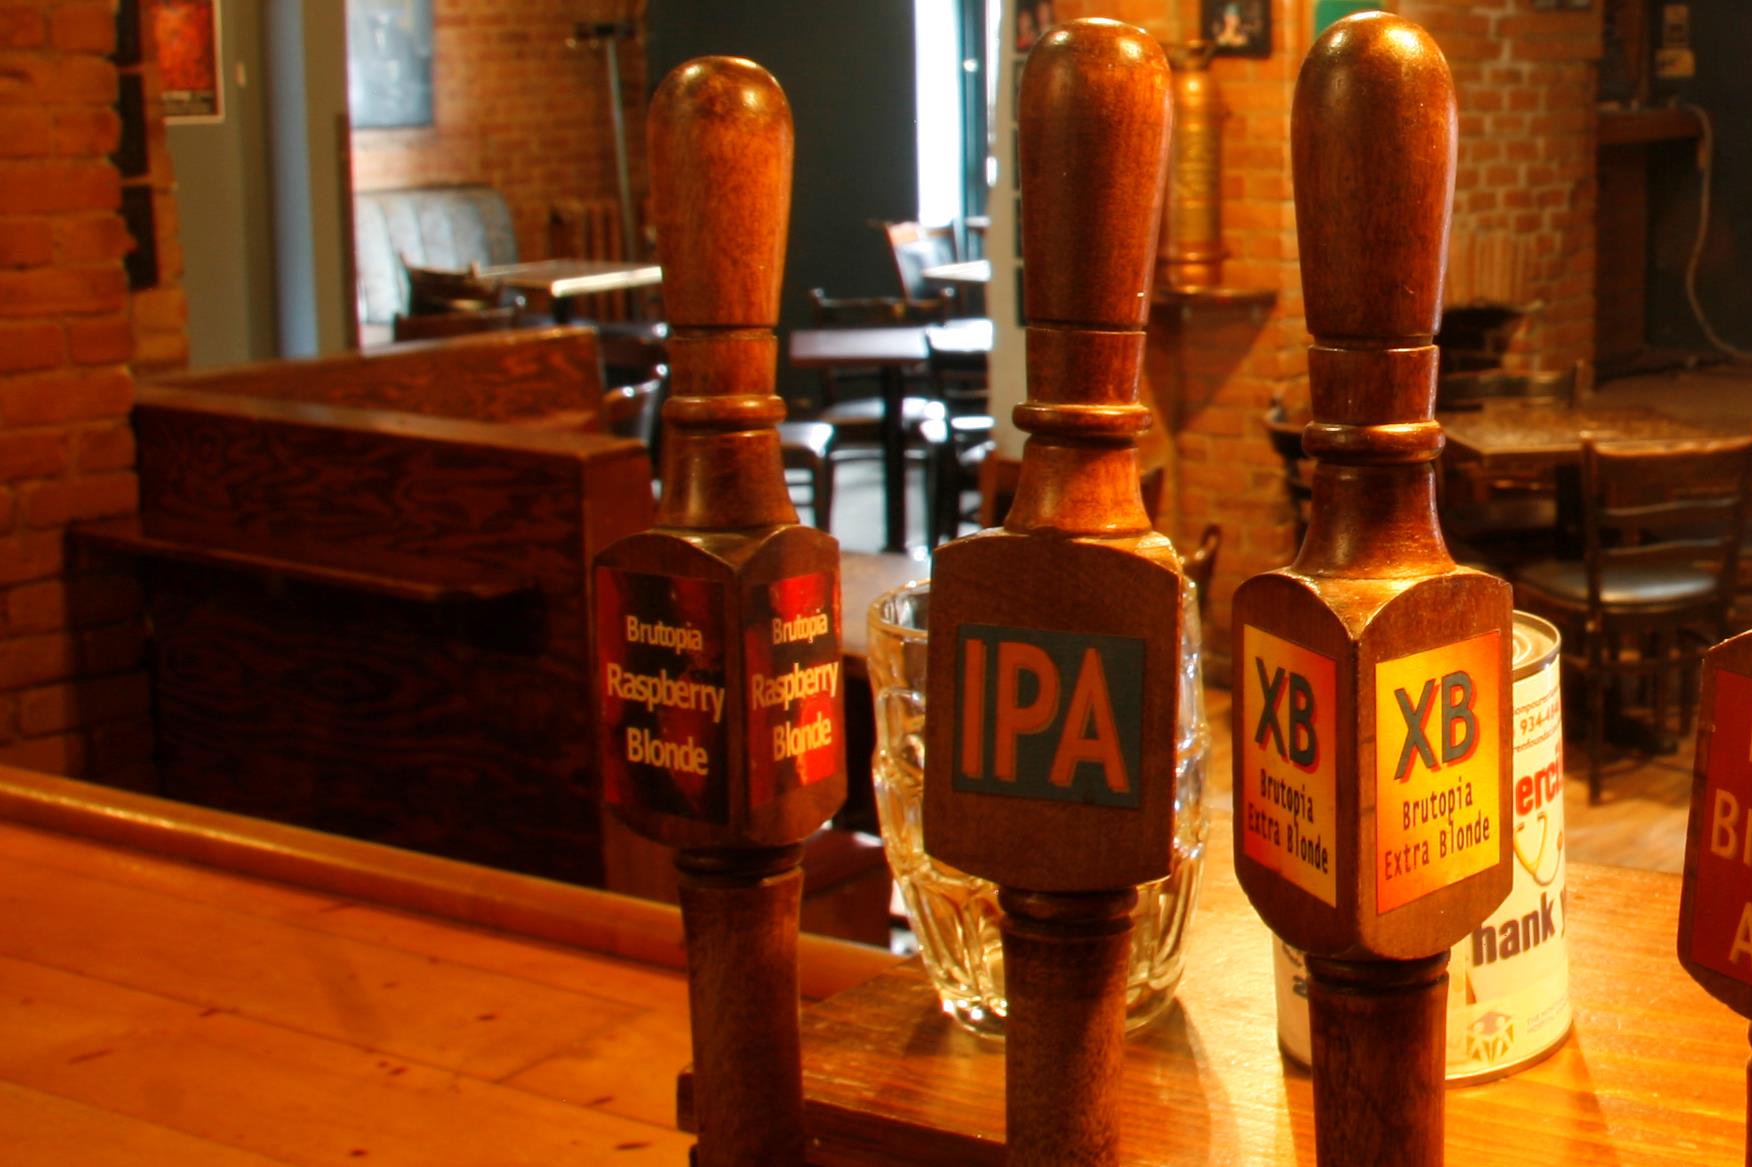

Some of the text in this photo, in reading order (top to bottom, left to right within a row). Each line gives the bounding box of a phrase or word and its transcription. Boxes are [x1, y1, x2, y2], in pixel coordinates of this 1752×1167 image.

[625, 614, 704, 655] Brutopia
[772, 608, 829, 645] Brutopia
[606, 662, 726, 724] Raspberry
[752, 661, 840, 711] Raspberry
[773, 711, 832, 762] Blonde
[961, 638, 1131, 793] IPA
[1254, 656, 1320, 775] XB
[1393, 669, 1480, 785] XB
[626, 726, 709, 776] Blonde
[1259, 767, 1315, 825] Brutopia
[1402, 775, 1473, 832] Brutopia
[1248, 802, 1329, 875] Extra Blonde
[1384, 811, 1491, 882] Extra Blonde
